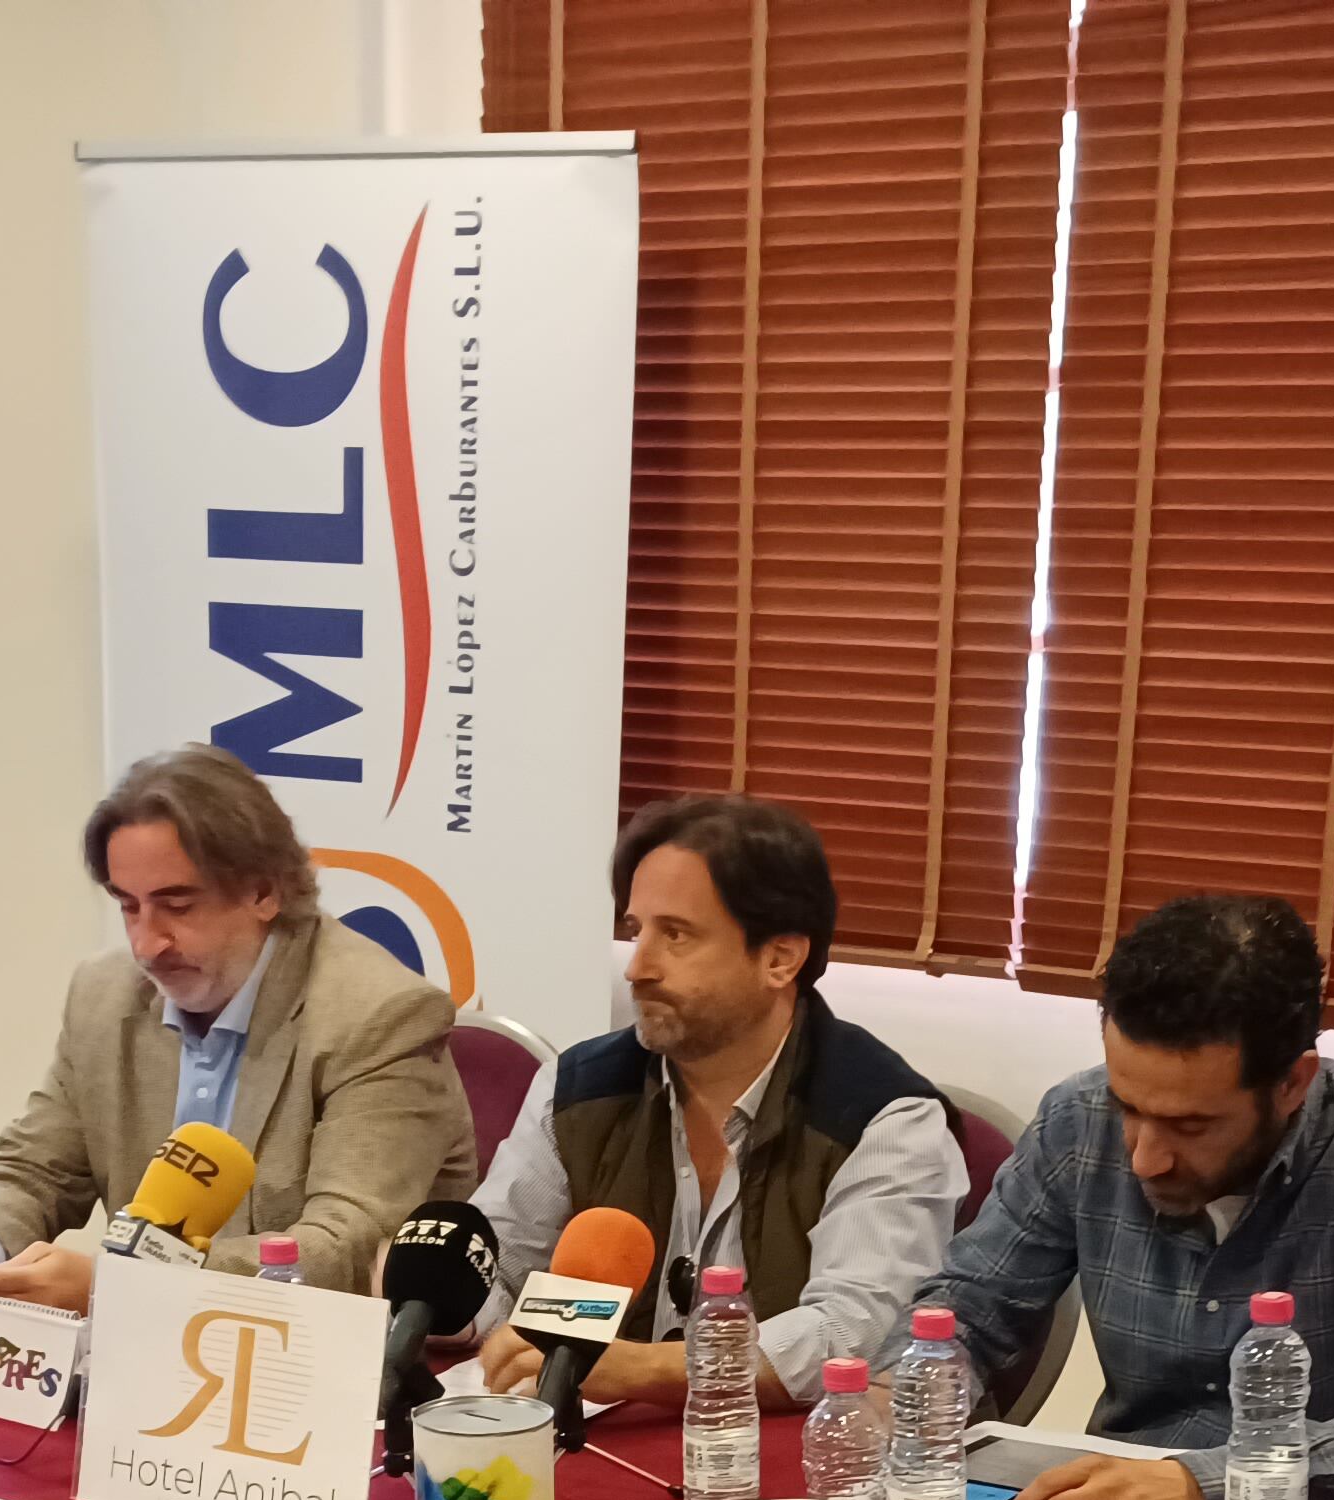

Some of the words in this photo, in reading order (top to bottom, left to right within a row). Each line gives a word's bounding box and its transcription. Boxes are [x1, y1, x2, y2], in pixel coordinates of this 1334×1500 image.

[452, 196, 483, 318] S.L.U.
[203, 243, 369, 784] MLC
[110, 1445, 205, 1498] Hotel
